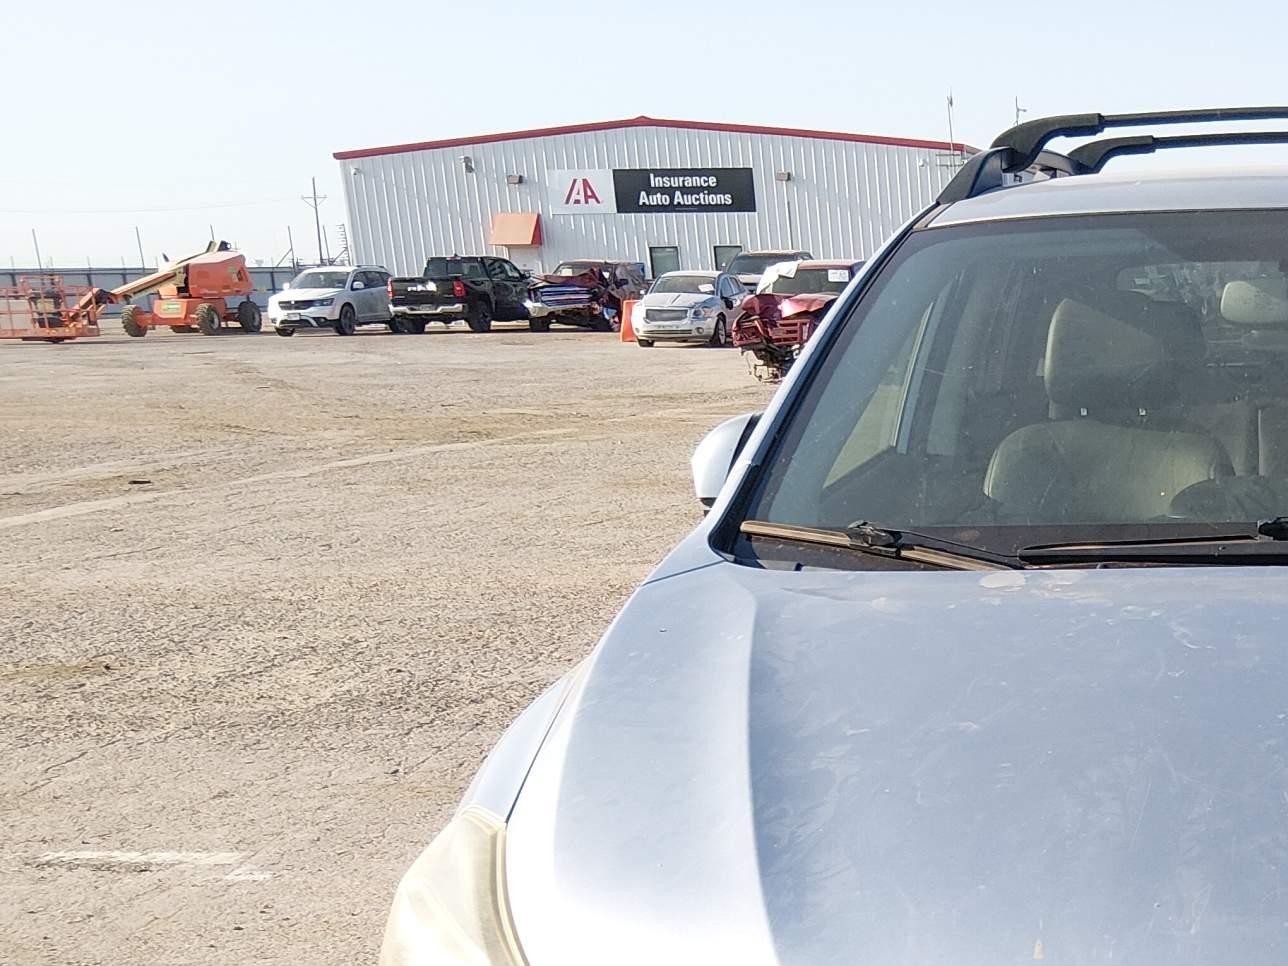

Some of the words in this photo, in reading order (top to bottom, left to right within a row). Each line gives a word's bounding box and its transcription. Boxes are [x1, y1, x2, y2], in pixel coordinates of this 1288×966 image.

[649, 173, 717, 188] Insurance
[638, 190, 670, 206] Auto
[673, 190, 733, 206] Auctions
